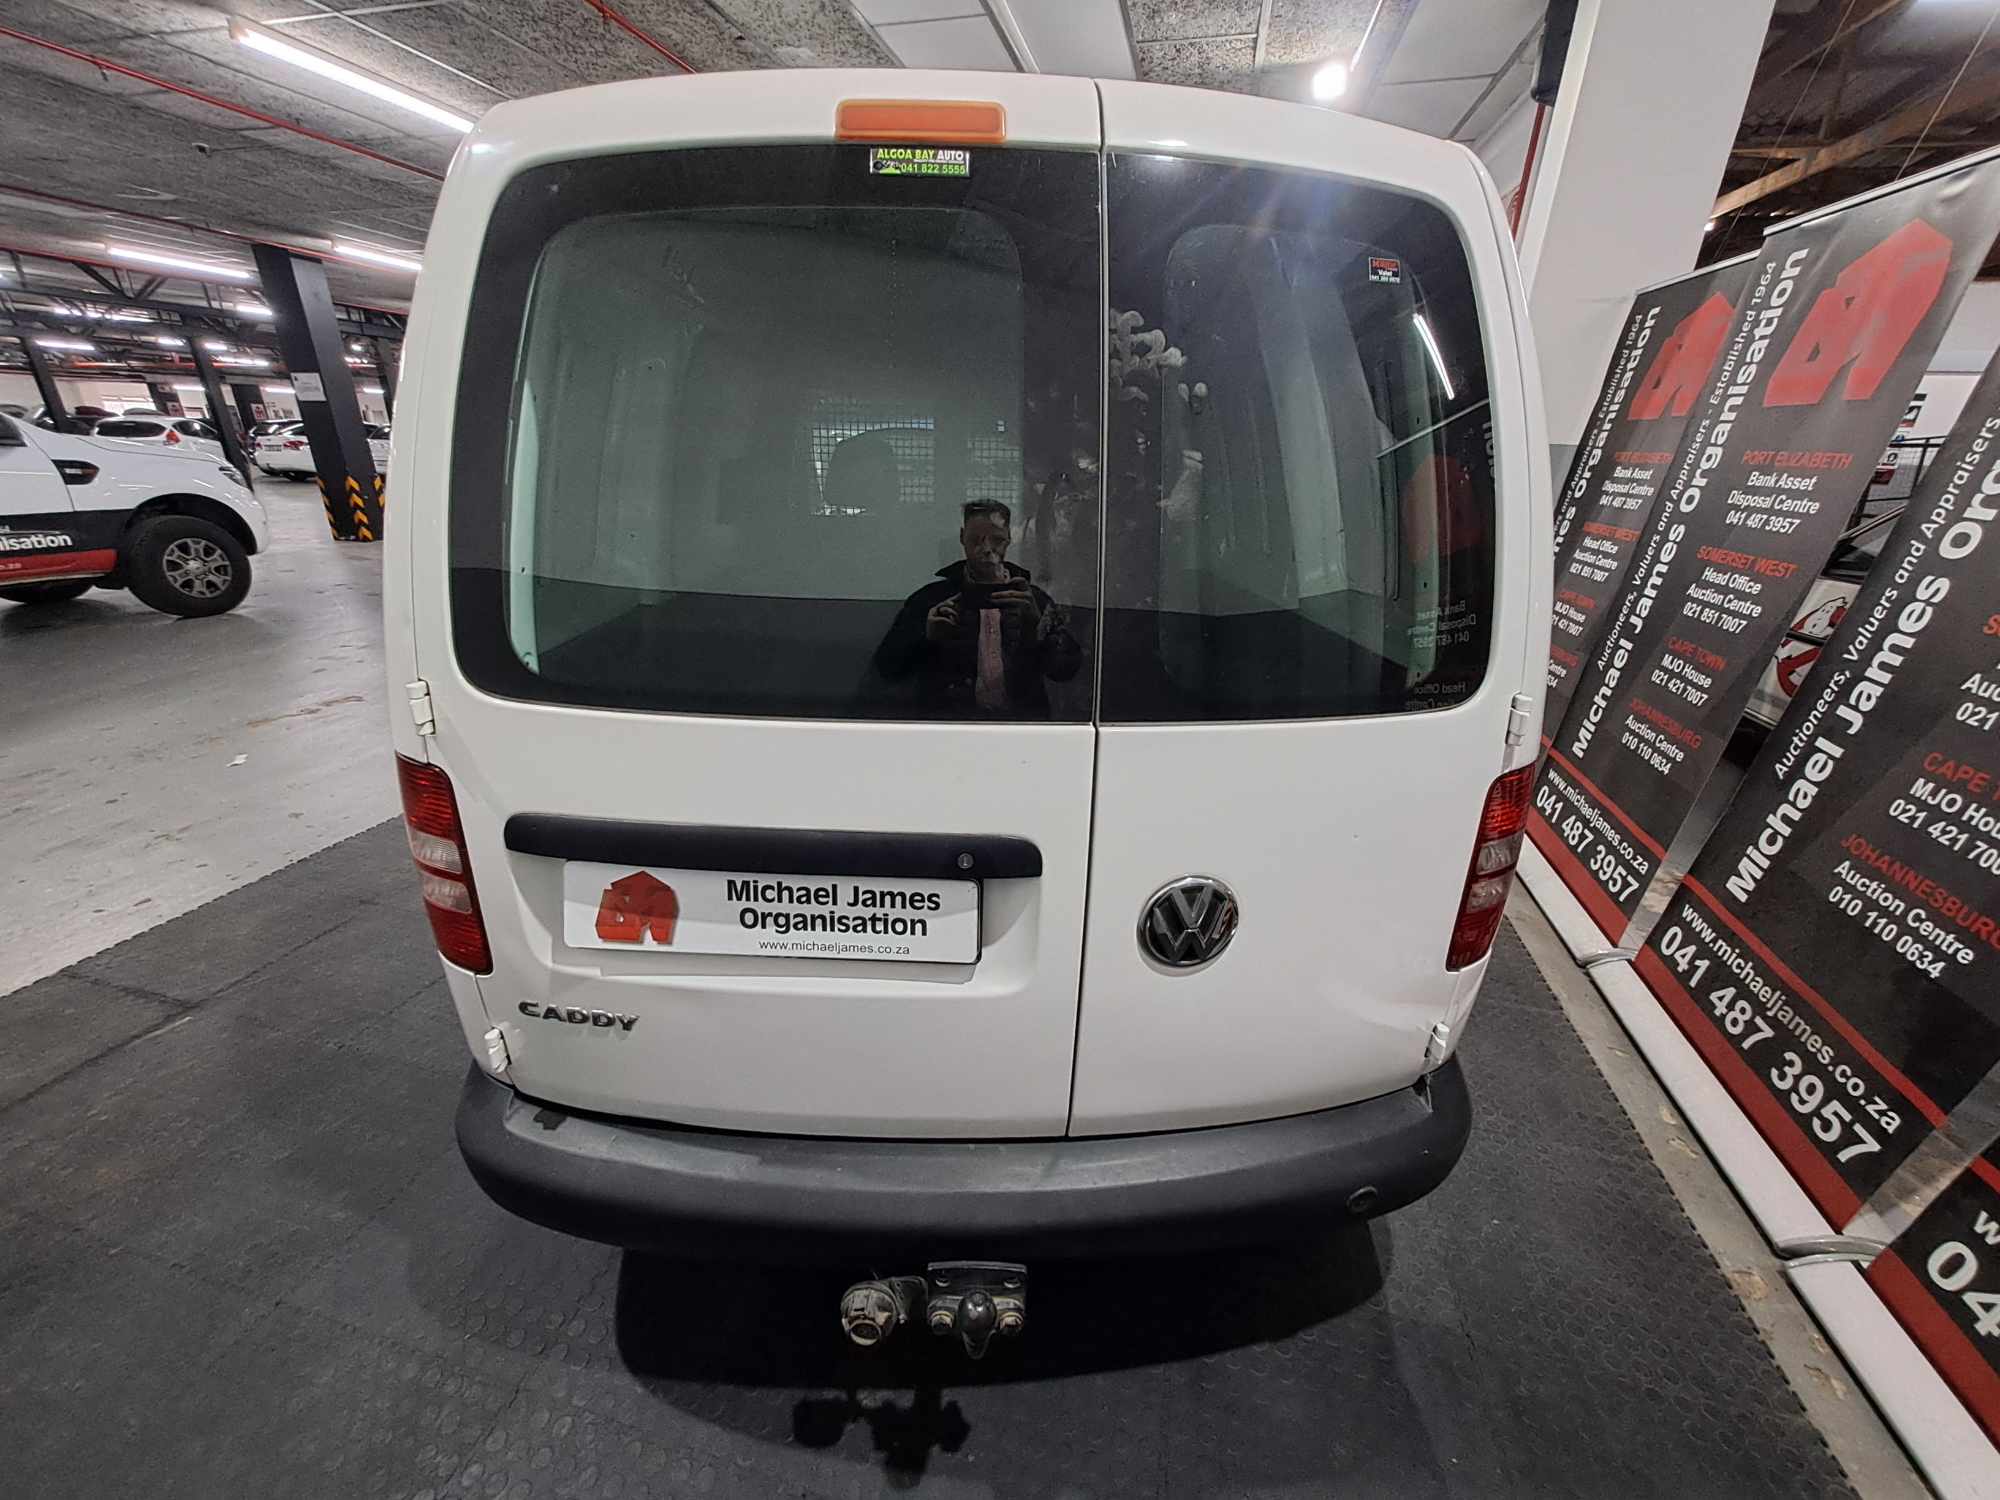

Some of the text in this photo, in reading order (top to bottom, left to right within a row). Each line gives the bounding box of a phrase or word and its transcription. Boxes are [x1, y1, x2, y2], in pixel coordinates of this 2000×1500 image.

[877, 148, 965, 161] ALGOA BAY AUTO
[900, 163, 918, 173] 041
[942, 164, 966, 175] 5555
[1574, 305, 1662, 498] Organisation
[1597, 590, 1638, 671] Auctioneers,
[1632, 534, 1662, 586] Valuers
[1656, 501, 1675, 531] and
[1670, 418, 1710, 500] Appraisers
[1709, 310, 1756, 405] Established
[1751, 261, 1777, 306] 1964
[1742, 450, 1853, 469] PORT ELIZABETH
[1747, 471, 1818, 491] Bank Asset
[1572, 637, 1634, 759] Michael
[1628, 523, 1687, 634] James
[1678, 248, 1810, 514] Organisation
[1725, 510, 1801, 534] 041 487 3957
[1727, 490, 1820, 514] Disposal Centre
[1696, 545, 1798, 578] SOMERSET WEST
[1701, 566, 1762, 595] Head Office
[1682, 601, 1748, 634] 021 851 7007
[1686, 583, 1762, 617] Auction Centre
[1773, 670, 1851, 781] Auctioneers,
[1842, 587, 1899, 661] Valuers
[1894, 540, 1926, 584] and
[1920, 416, 2000, 539] Appraisers
[1651, 669, 1709, 707] 021 421 7007
[1661, 653, 1713, 688] MJO House
[1956, 702, 2000, 731] 021
[1621, 731, 1672, 775] 010 110 0634
[1624, 714, 1685, 762] Auction Centre
[1725, 574, 1951, 903] Michael James
[1923, 751, 1991, 793] CAPE
[1547, 767, 1650, 876] www.michaeljames.co.za
[1909, 777, 1963, 814] MJO
[1961, 803, 2000, 841] Hou
[1536, 785, 1640, 902] 041 487 3957
[1889, 799, 2000, 876] 021 421 700
[726, 879, 941, 911] Michael James
[1833, 860, 1975, 965] Auction Centre
[739, 907, 928, 935] Organisation
[1828, 886, 1946, 979] 010 110 0634
[758, 940, 910, 955] www.michaeljames.co.za
[518, 1000, 640, 1031] CADDY
[1681, 903, 1902, 1135] www.michaeljames.co.za
[1661, 926, 1883, 1164] 041 487 3957
[1927, 1240, 2000, 1338] 04
